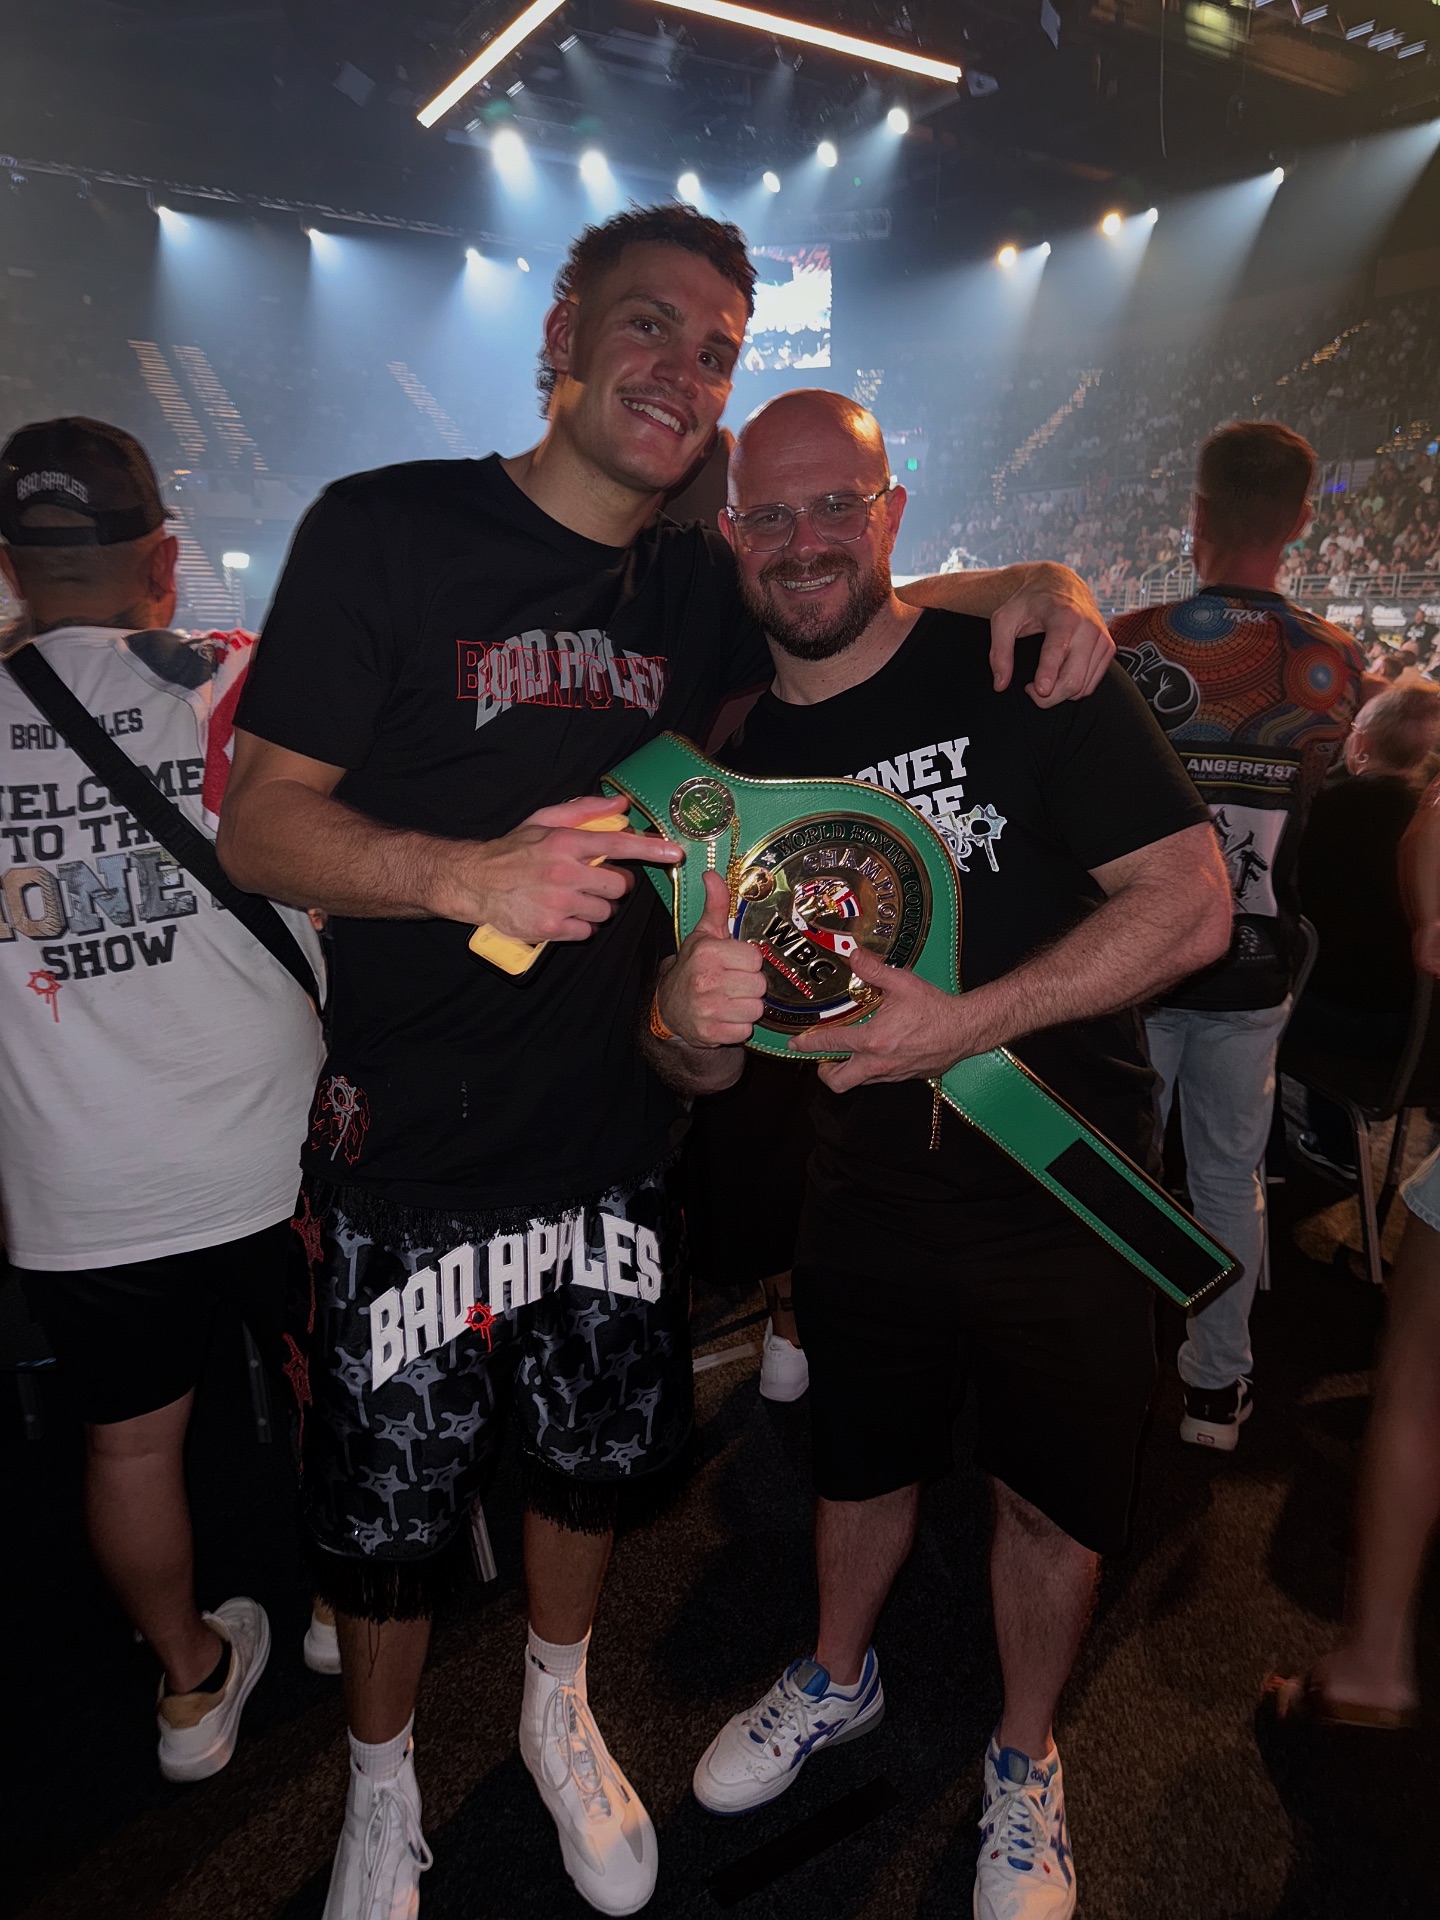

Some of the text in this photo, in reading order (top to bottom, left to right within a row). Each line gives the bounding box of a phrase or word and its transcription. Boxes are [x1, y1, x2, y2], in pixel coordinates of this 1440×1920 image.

[10, 724, 57, 749] BAD
[1187, 758, 1298, 779] ANGERFIST
[0, 758, 205, 822] ELCME
[2, 824, 64, 862] TO
[0, 847, 230, 943] ONE
[775, 823, 921, 960] WORLD BOXING COUNCIL
[803, 848, 897, 939] CHAMPION
[41, 925, 177, 981] SHOW
[763, 912, 838, 985] WBC
[370, 1206, 662, 1392] BAD APPLES
